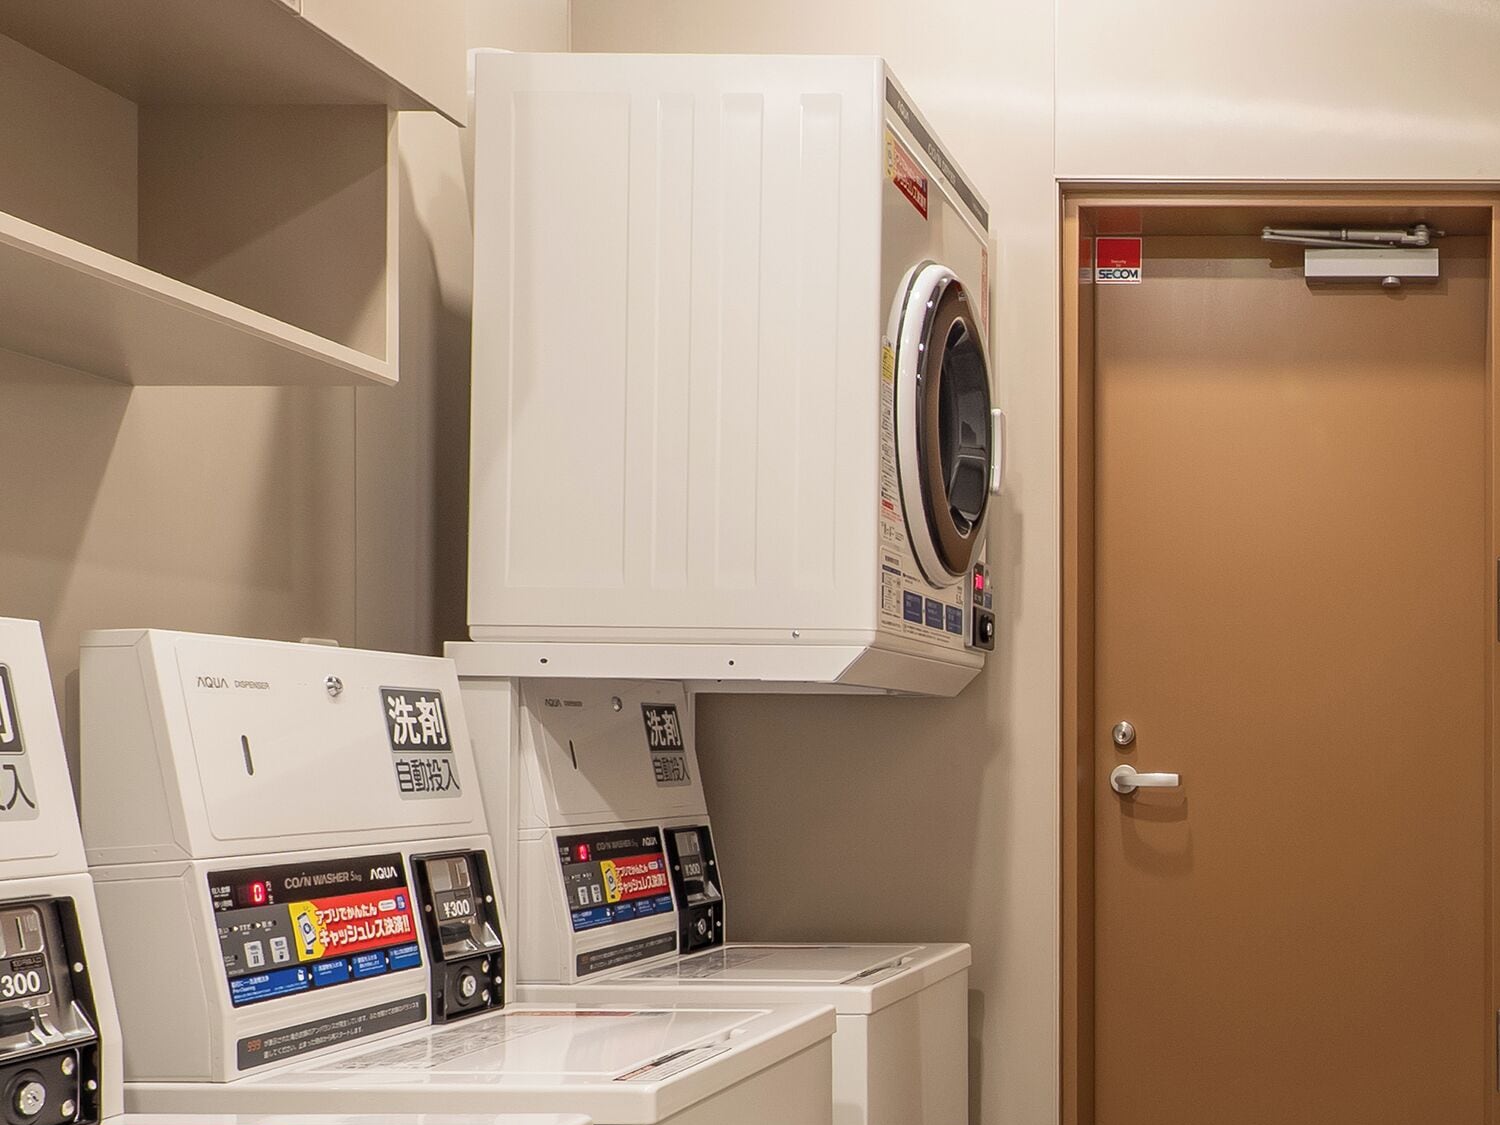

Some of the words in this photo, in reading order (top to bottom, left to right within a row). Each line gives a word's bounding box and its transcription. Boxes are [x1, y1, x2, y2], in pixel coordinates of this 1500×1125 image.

[1099, 269, 1138, 279] SECOM
[197, 677, 229, 688] AQUA
[387, 695, 447, 745] 洗剤
[647, 710, 681, 746] 洗剤
[395, 759, 460, 792] 自動投入
[652, 757, 691, 782] 自動投入
[284, 871, 311, 889] COIN
[312, 873, 349, 886] WASHER
[370, 866, 397, 880] AQUA
[315, 902, 378, 925] アプリでかんたん
[443, 900, 470, 918] ¥300
